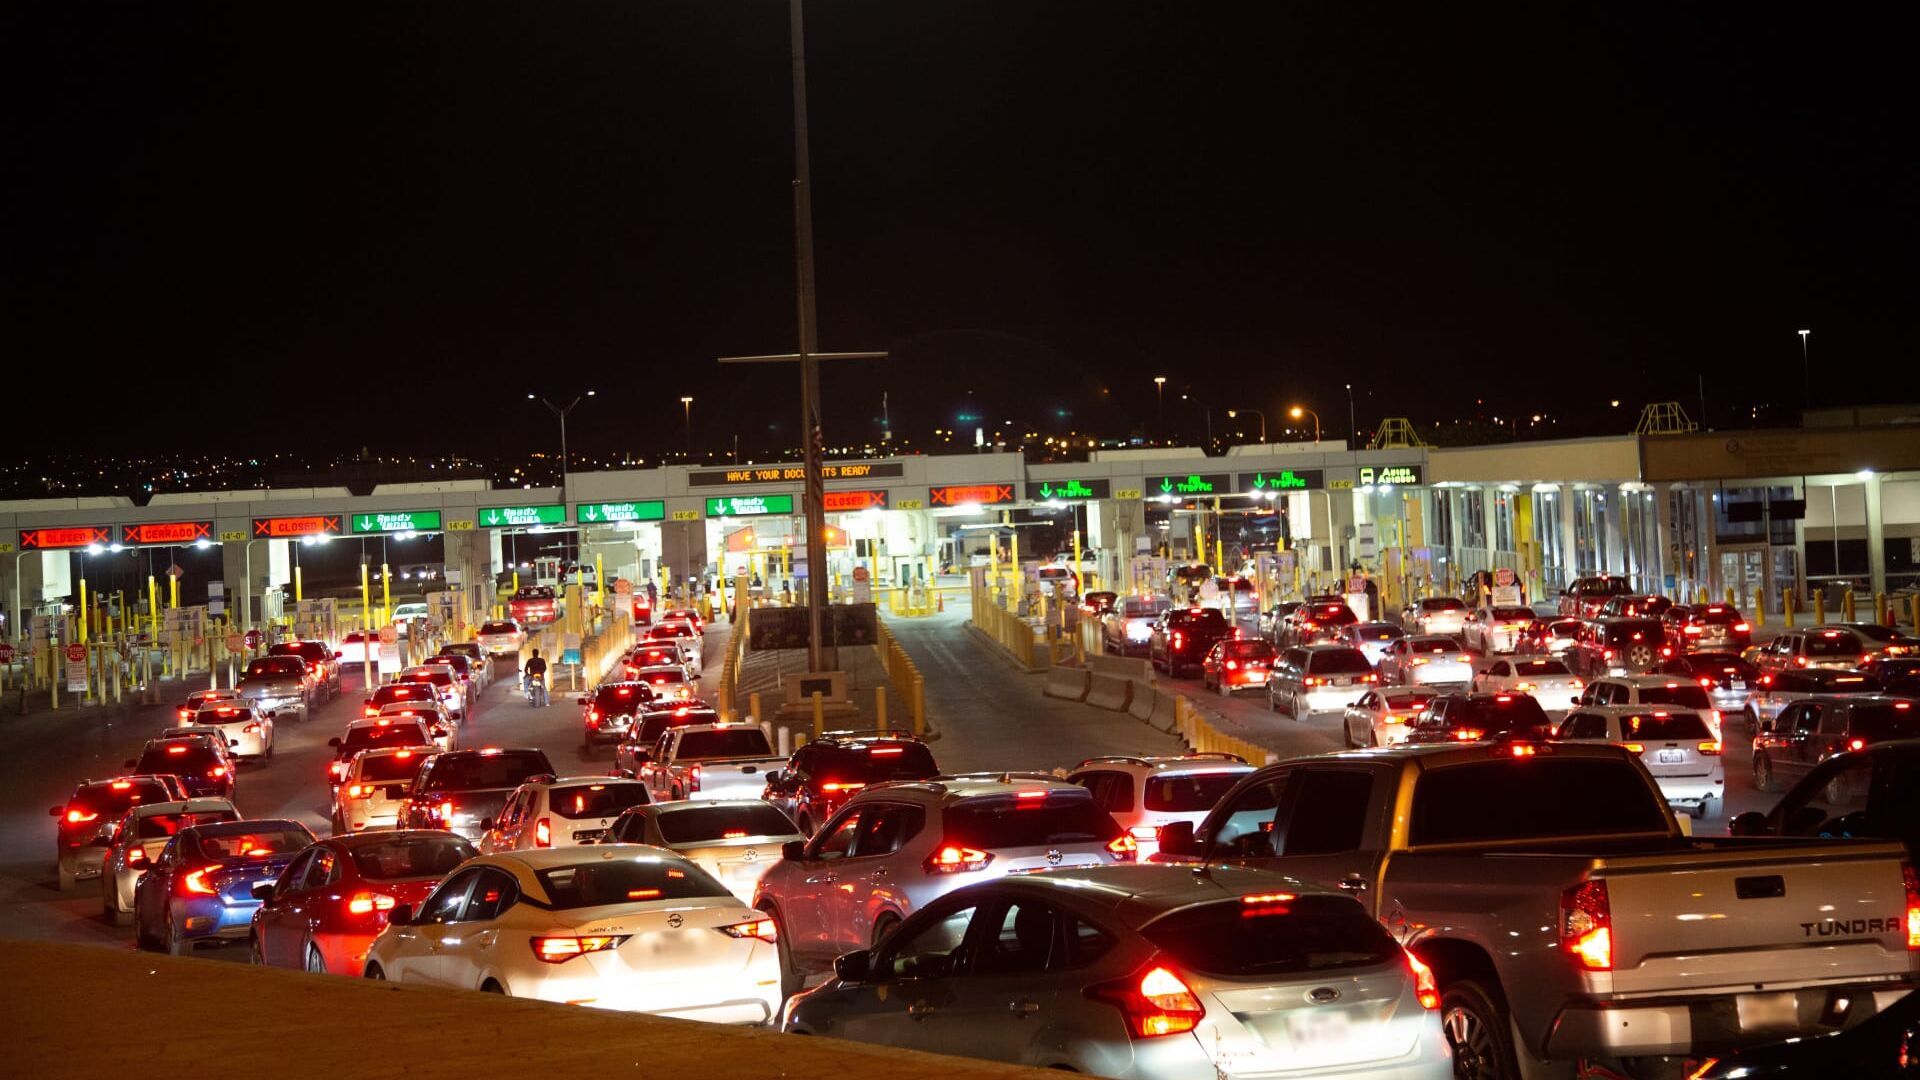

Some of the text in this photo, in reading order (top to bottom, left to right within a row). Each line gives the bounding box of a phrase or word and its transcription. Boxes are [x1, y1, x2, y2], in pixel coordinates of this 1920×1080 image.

[727, 471, 751, 481] HAVE
[755, 469, 780, 480] YOUR
[841, 465, 871, 477] READY
[1177, 483, 1213, 493] Traffic
[1270, 478, 1305, 488] Traffic
[1056, 487, 1092, 498] Traffic
[731, 497, 764, 507] Ready
[826, 496, 865, 507] CLOSED
[504, 507, 538, 517] Ready
[602, 503, 635, 513] Ready
[377, 513, 411, 523] Ready
[278, 521, 317, 532] CLOSED
[46, 533, 86, 544] CLOSED
[144, 528, 193, 539] CERRADO
[1800, 917, 1900, 936] TUNDRA
